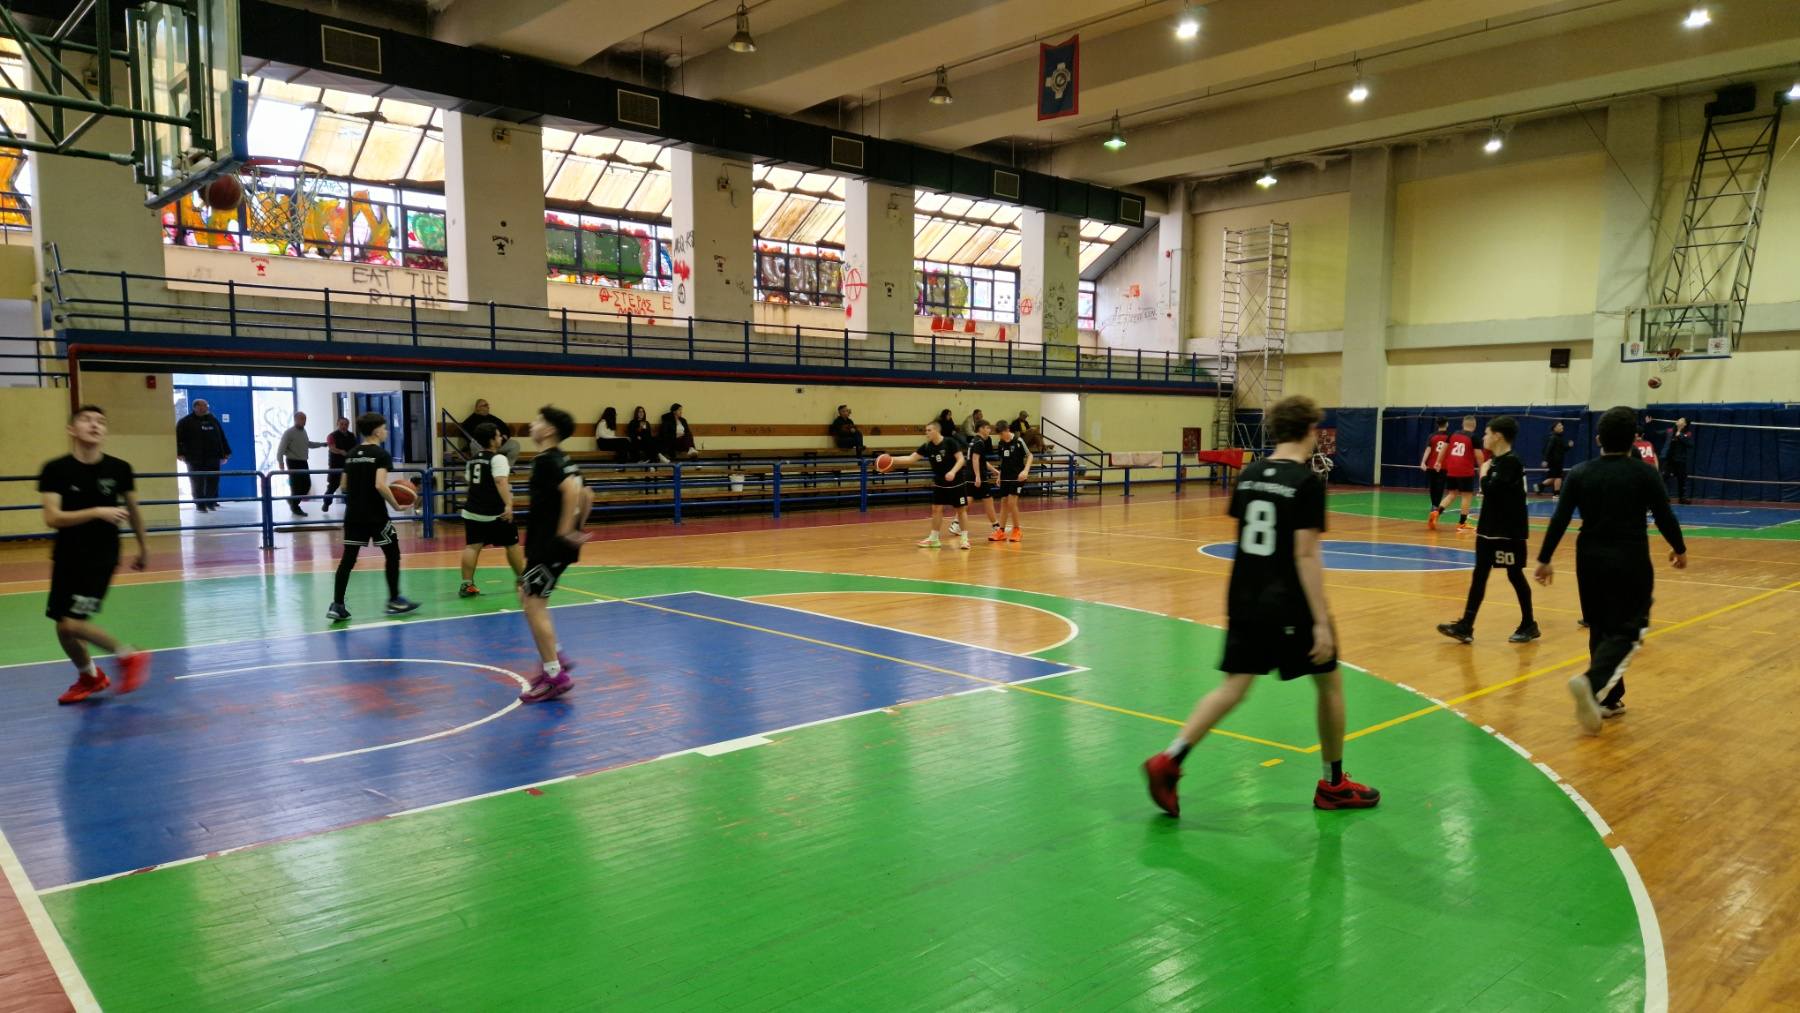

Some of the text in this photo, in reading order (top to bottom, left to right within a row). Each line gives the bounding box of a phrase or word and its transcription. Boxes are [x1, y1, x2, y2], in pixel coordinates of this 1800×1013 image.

[352, 266, 447, 296] EAT THE
[1451, 441, 1466, 457] 20
[1638, 446, 1653, 458] 24
[1240, 499, 1277, 557] 8
